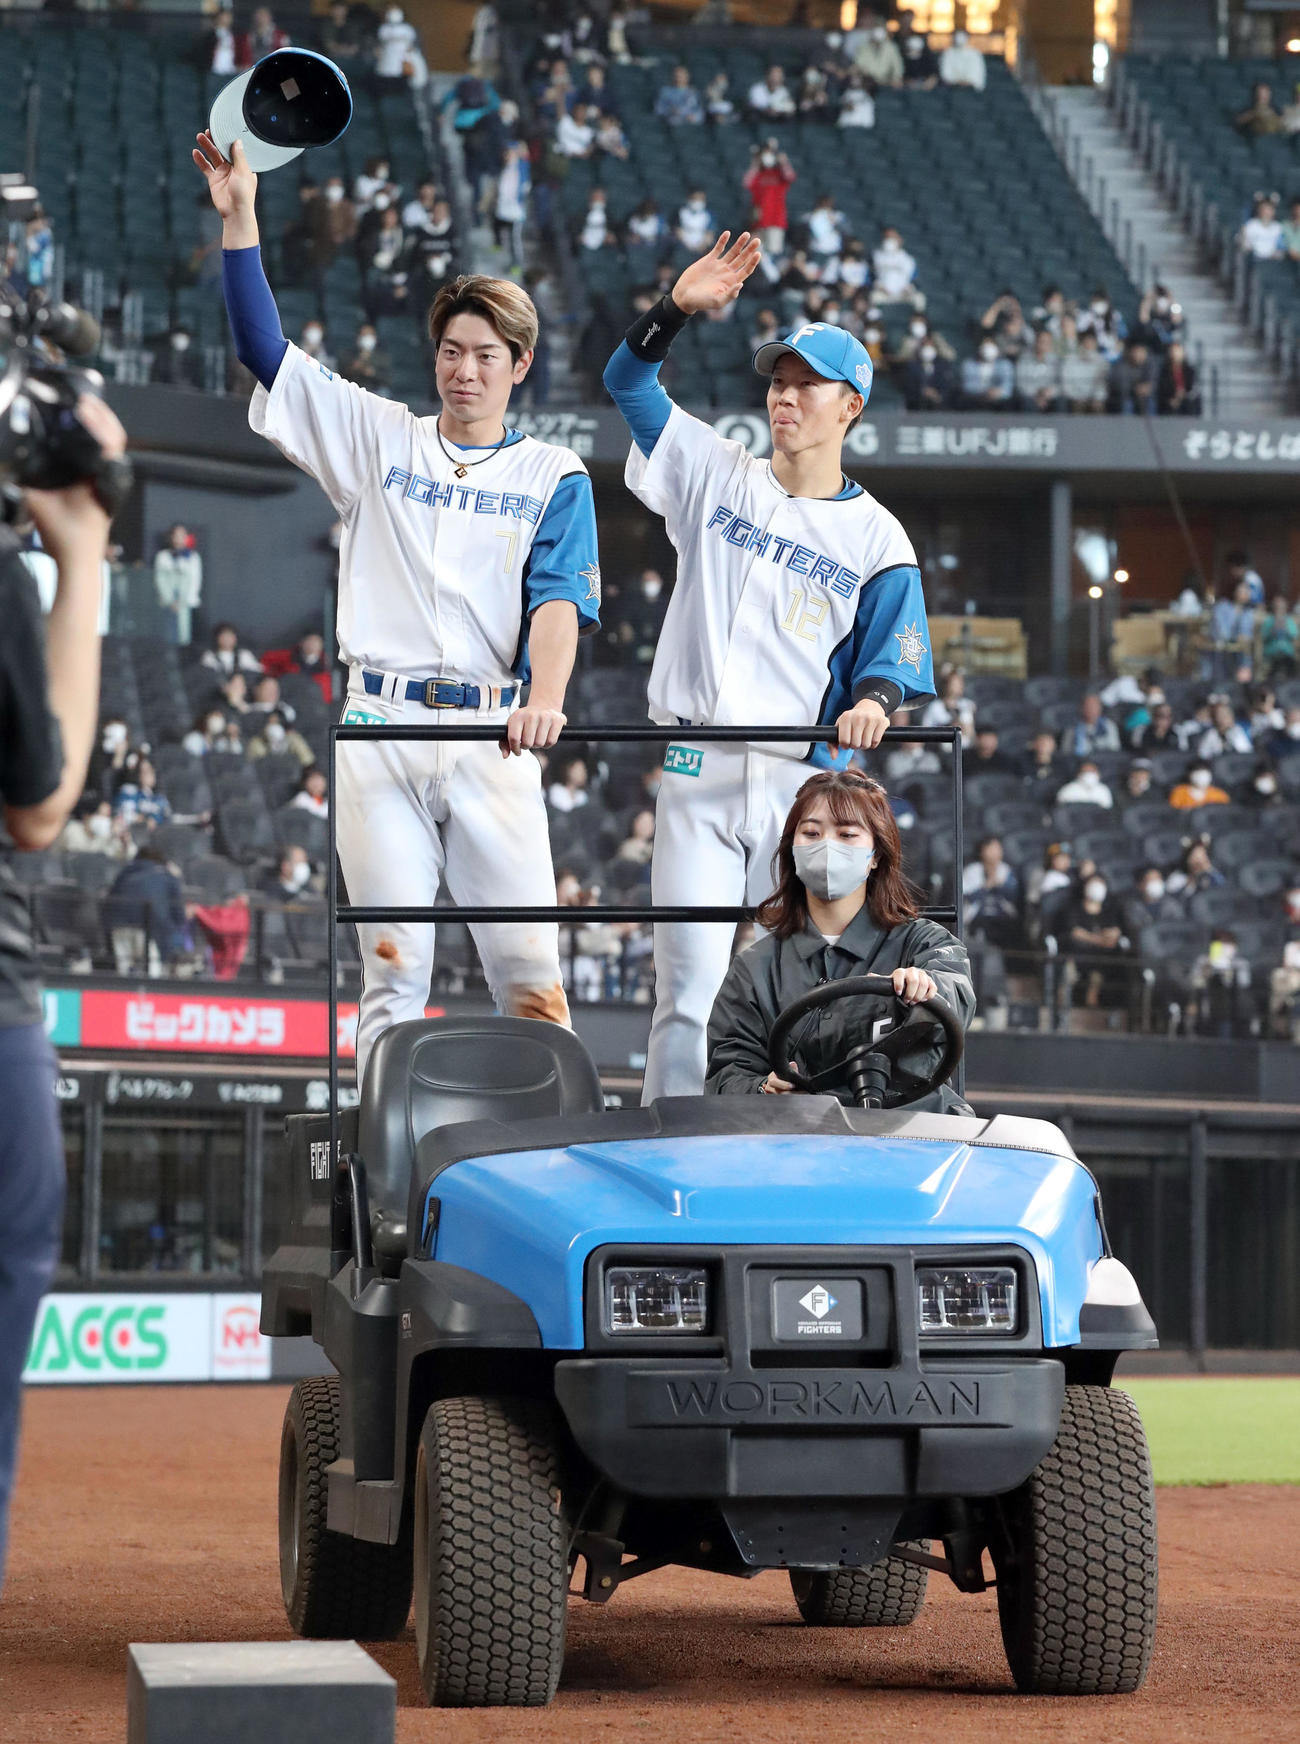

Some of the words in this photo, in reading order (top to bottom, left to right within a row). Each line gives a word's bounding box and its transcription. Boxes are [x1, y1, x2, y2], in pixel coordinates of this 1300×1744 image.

[791, 323, 825, 346] F
[383, 465, 545, 526] FGHTERS
[495, 530, 518, 575] 7
[706, 505, 862, 600] FIGHTERS
[781, 588, 831, 642] 12
[666, 750, 700, 770] ニトリ
[126, 1000, 286, 1046] ビックカメラ
[811, 1292, 827, 1312] F
[29, 1304, 168, 1370] ACCS
[797, 1326, 842, 1334] FIGHTERS
[667, 1380, 979, 1416] WORKMAN
